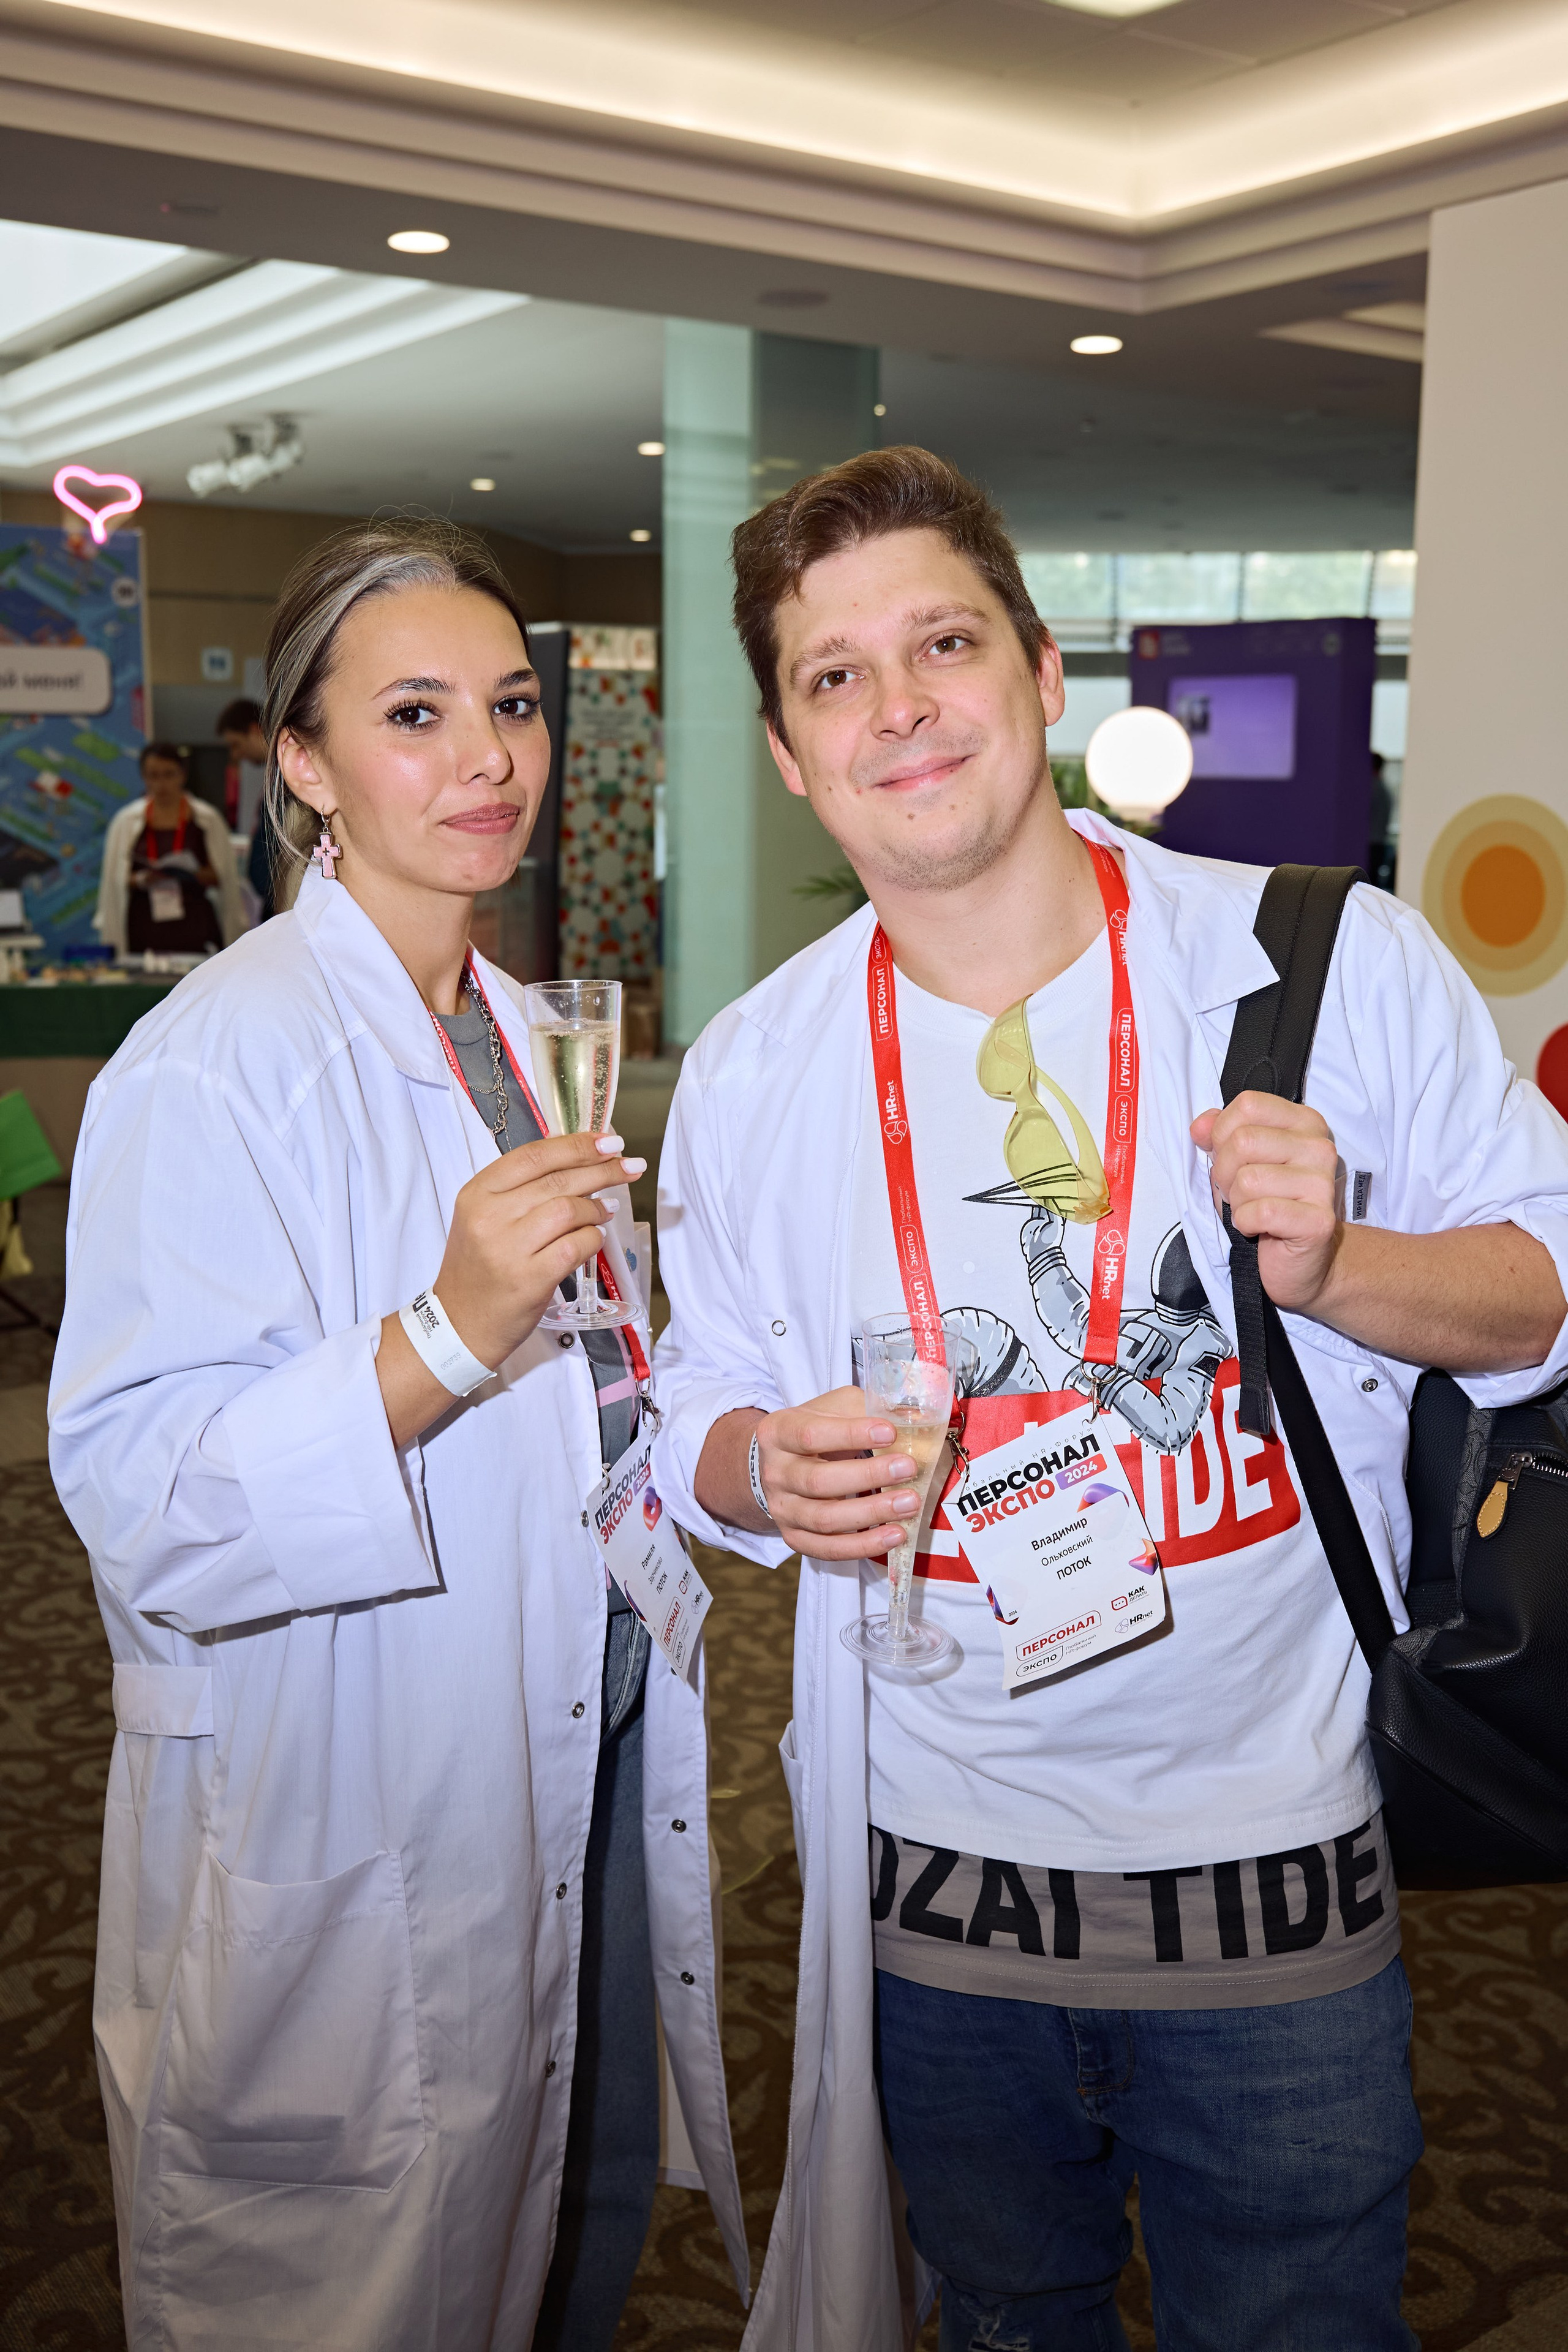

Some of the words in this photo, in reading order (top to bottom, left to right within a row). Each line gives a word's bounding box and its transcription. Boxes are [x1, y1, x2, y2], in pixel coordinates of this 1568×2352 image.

[876, 968, 889, 1035] ПЕРСОНАЛ
[1120, 1014, 1132, 1087] ПЕРСОНАЛ
[885, 1080, 899, 1120] HRnet
[1118, 1101, 1128, 1136] ЭКСПО
[1120, 1145, 1128, 1184] Глобальный
[897, 1185, 906, 1224] Глобальный
[906, 1231, 918, 1267] ЭКСПО
[1101, 1257, 1119, 1300] HRnet
[424, 1306, 440, 1329] 2024
[440, 1352, 461, 1370] 002739
[594, 1444, 651, 1529] ПЕРСОНАЛ
[957, 1433, 1100, 1517] ПЕРСОНАЛ
[965, 1460, 1024, 1491] обальный
[600, 1488, 633, 1544] ЭКСПО
[636, 1470, 650, 1490] 2024
[965, 1479, 1055, 1533] ЭКСПО
[1065, 1460, 1098, 1484] 2024
[1031, 1518, 1088, 1551] Владимир
[1041, 1535, 1093, 1566] Ольховский
[641, 1544, 655, 1570] Рамиля
[1057, 1556, 1092, 1580] ПОТОК
[656, 1571, 668, 1595] ПОТОК
[1128, 1585, 1145, 1597] КАК
[1129, 1591, 1148, 1602] ДЕЛАТЬ
[663, 1601, 681, 1648] ПЕРСОНАЛ
[1129, 1610, 1153, 1625] HRnet
[675, 1641, 684, 1663] ЭКСПО
[1022, 1615, 1095, 1657] ПЕРСОНАЛ
[1065, 1634, 1097, 1651] Глобальный
[1066, 1642, 1092, 1655] HR-форум
[1022, 1654, 1057, 1672] ЭКСПО
[1123, 1821, 1385, 1962] TIDE
